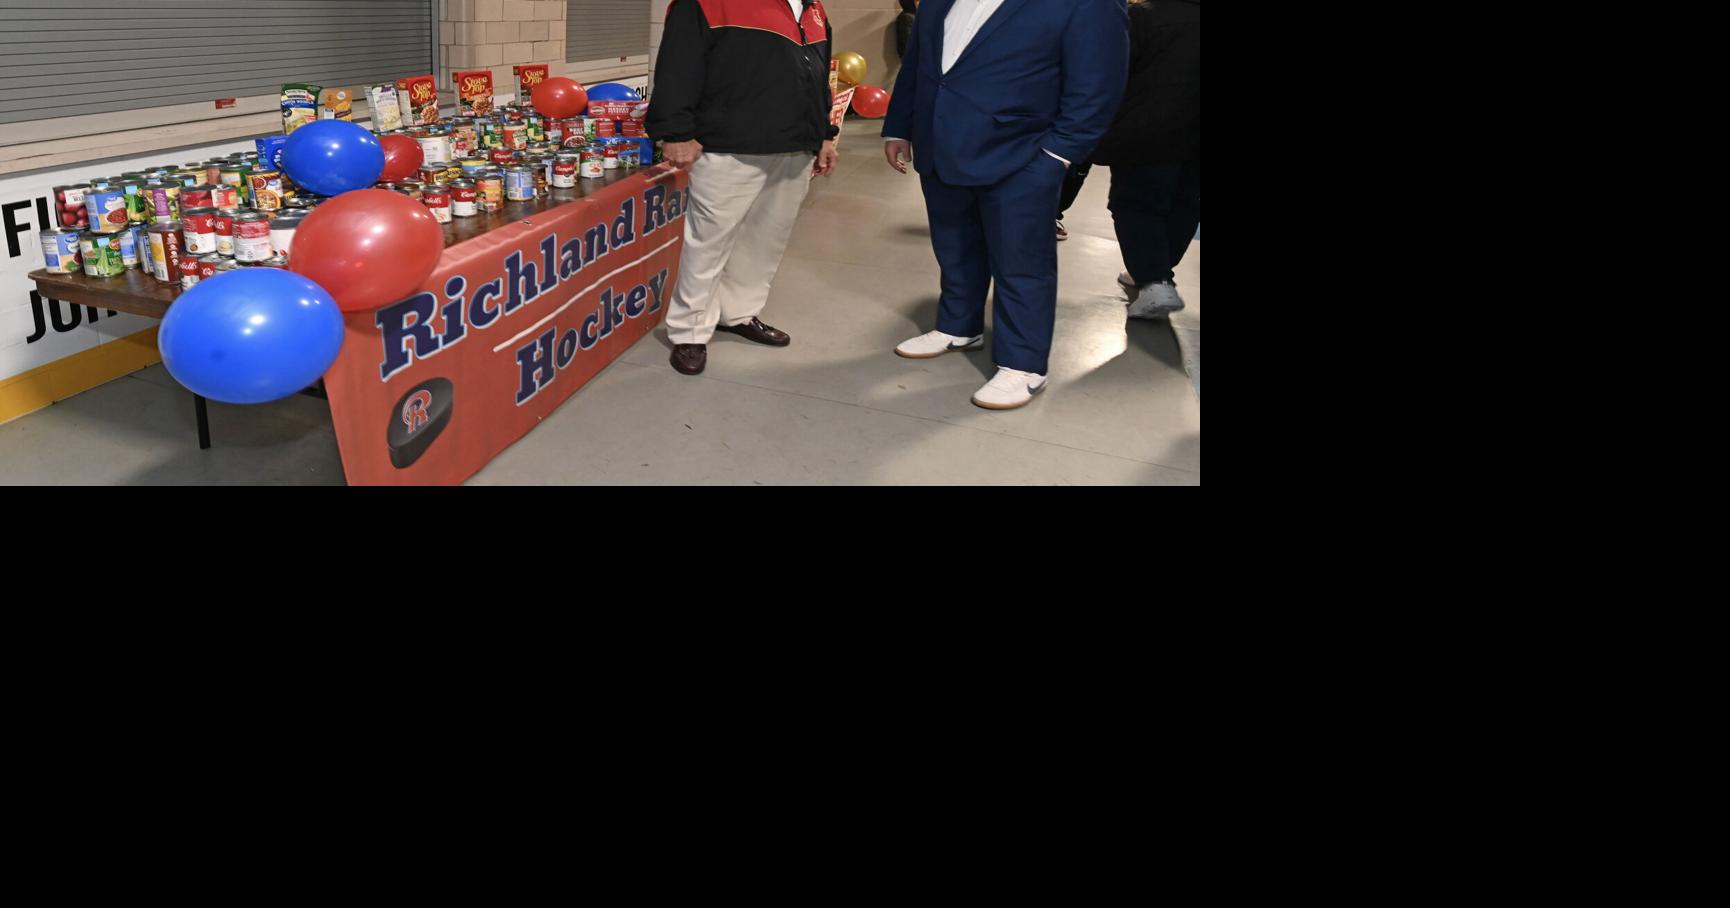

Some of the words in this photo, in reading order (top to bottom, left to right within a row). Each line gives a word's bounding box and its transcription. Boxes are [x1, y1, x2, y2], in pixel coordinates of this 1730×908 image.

[461, 76, 488, 92] Stove
[522, 69, 544, 84] Stove
[411, 81, 432, 99] Stove
[471, 83, 485, 95] Top
[375, 197, 635, 382] Richland
[26, 289, 118, 345] JU
[516, 268, 668, 406] Hockey
